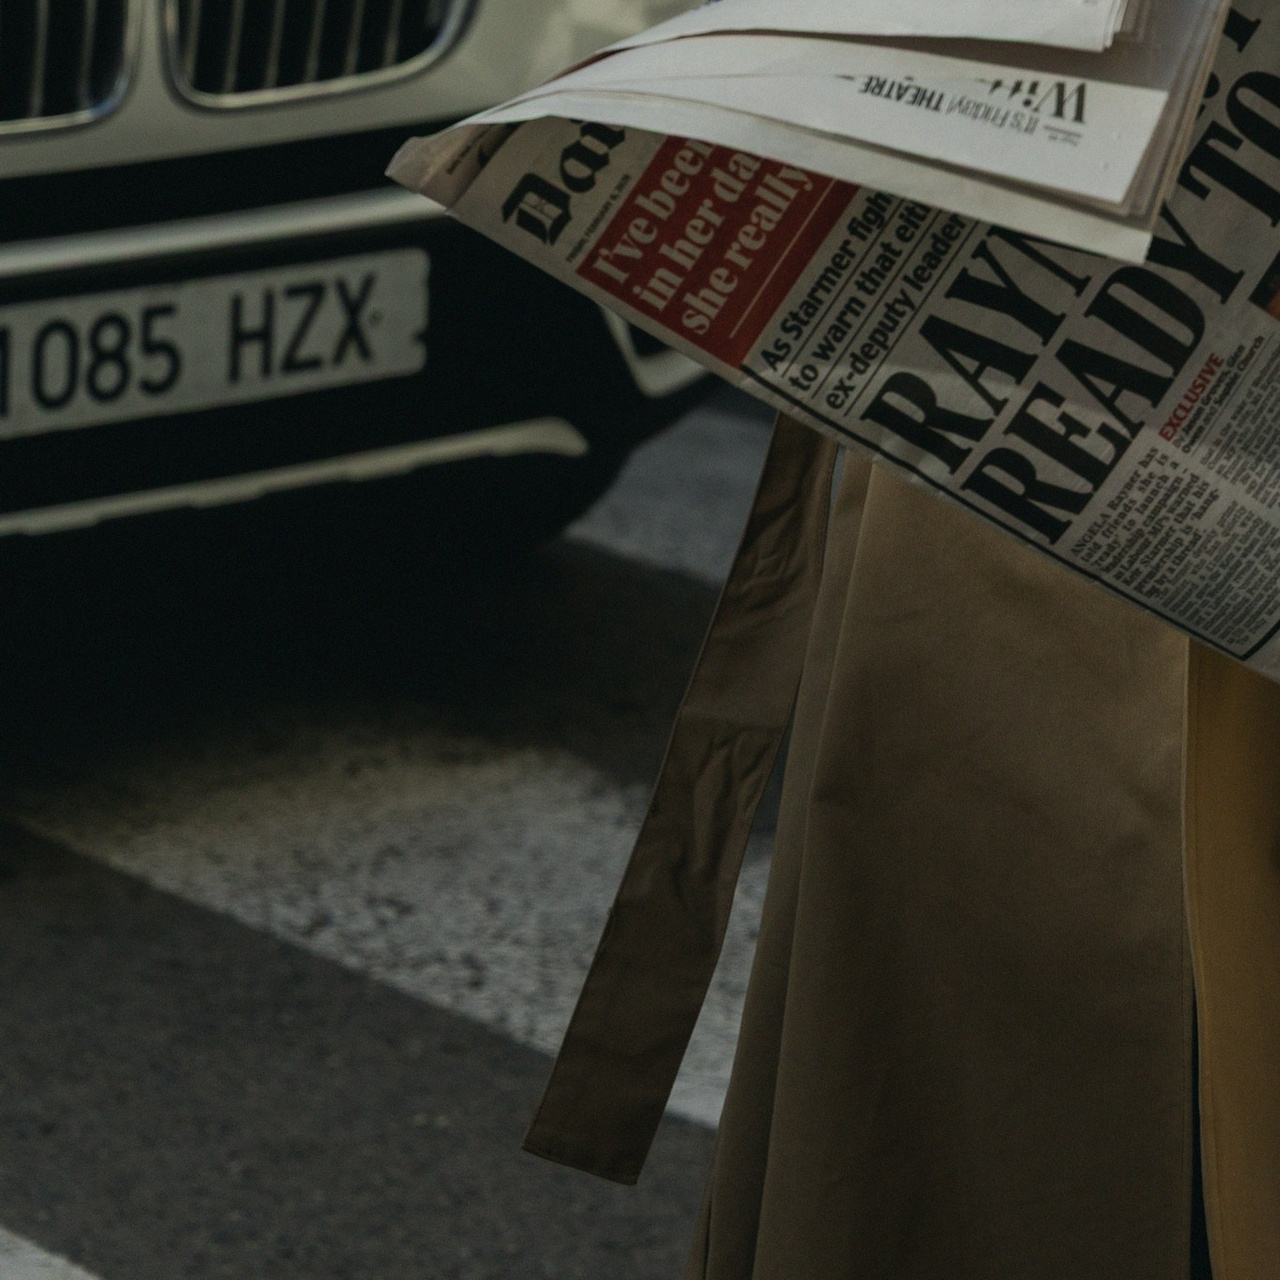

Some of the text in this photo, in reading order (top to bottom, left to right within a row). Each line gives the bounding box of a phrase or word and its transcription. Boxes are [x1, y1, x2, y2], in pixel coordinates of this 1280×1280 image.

[856, 73, 945, 112] THEATRE
[587, 206, 662, 286] I've
[630, 139, 765, 313] in her da
[670, 154, 817, 337] she really
[228, 272, 376, 384] HZX
[760, 337, 792, 370] As
[780, 240, 856, 340] Starmer
[788, 363, 819, 392] to
[812, 296, 866, 361] warn
[854, 242, 902, 296] that
[826, 288, 916, 409] ex-deputy
[972, 210, 1238, 548] READY
[1157, 350, 1225, 442] EXCLUSIVE
[1100, 495, 1137, 539] friends
[1135, 469, 1157, 493] she
[1106, 468, 1144, 512] Rayner
[1138, 445, 1159, 468] has
